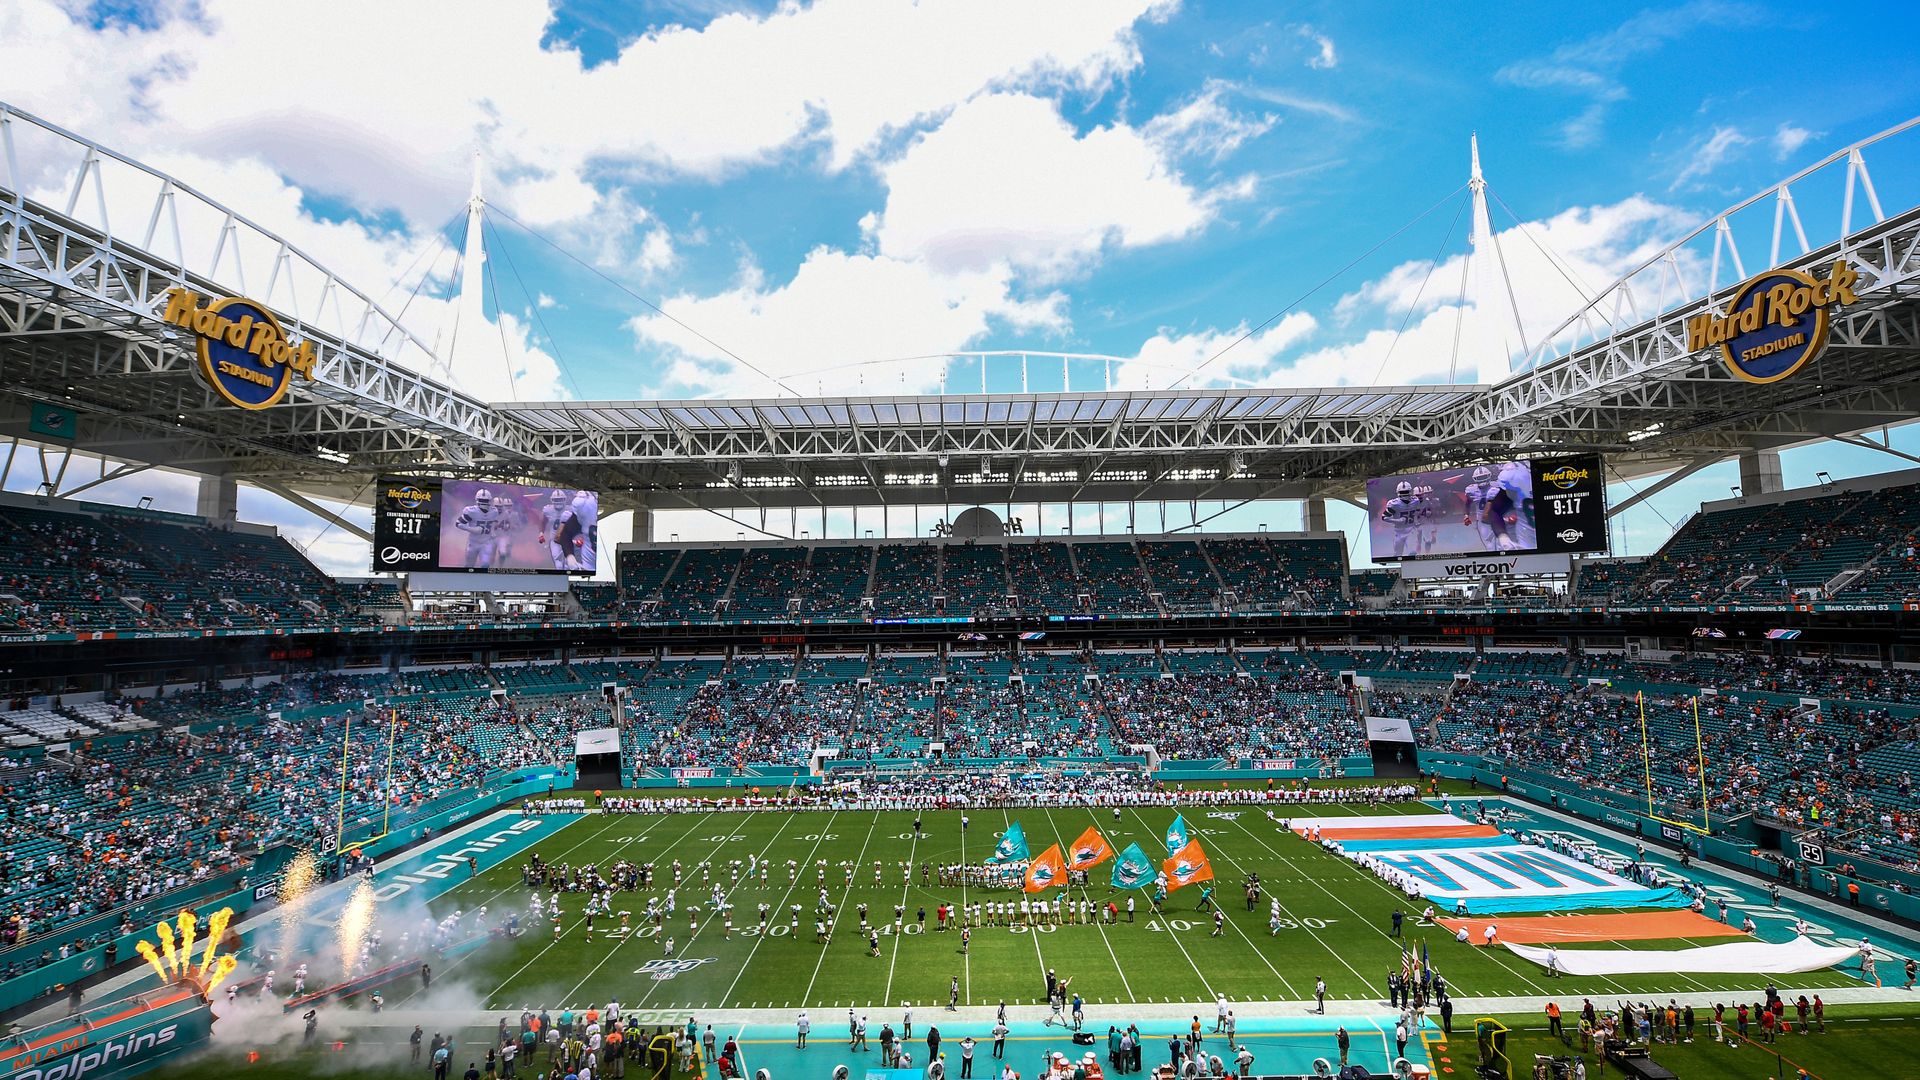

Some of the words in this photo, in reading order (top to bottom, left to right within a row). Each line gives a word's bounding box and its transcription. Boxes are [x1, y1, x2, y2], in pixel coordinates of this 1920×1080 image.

[1687, 292, 1766, 352] Hard
[1766, 261, 1859, 328] Rock
[163, 287, 253, 349] Hard
[248, 322, 317, 381] Rock
[1742, 332, 1805, 362] STADIUM
[218, 361, 274, 388] STADIUM
[1542, 472, 1566, 481] Hard
[1566, 469, 1588, 480] Rock
[388, 489, 411, 499] Hard
[411, 490, 431, 501] Rock
[1554, 498, 1580, 515] 9:17
[395, 518, 421, 534] 9:17
[402, 552, 431, 561] pepsi
[1445, 561, 1510, 575] verizon
[1265, 762, 1291, 770] KICKOFF
[684, 770, 711, 778] KICKOFF
[448, 811, 470, 823] Dolphins
[1606, 813, 1637, 829] Dolphins
[324, 837, 336, 850] 25
[1803, 845, 1820, 861] 25
[741, 925, 790, 936] 30
[876, 923, 922, 935] 40
[1145, 920, 1192, 931] 40
[13, 1036, 88, 1070] MIAMI
